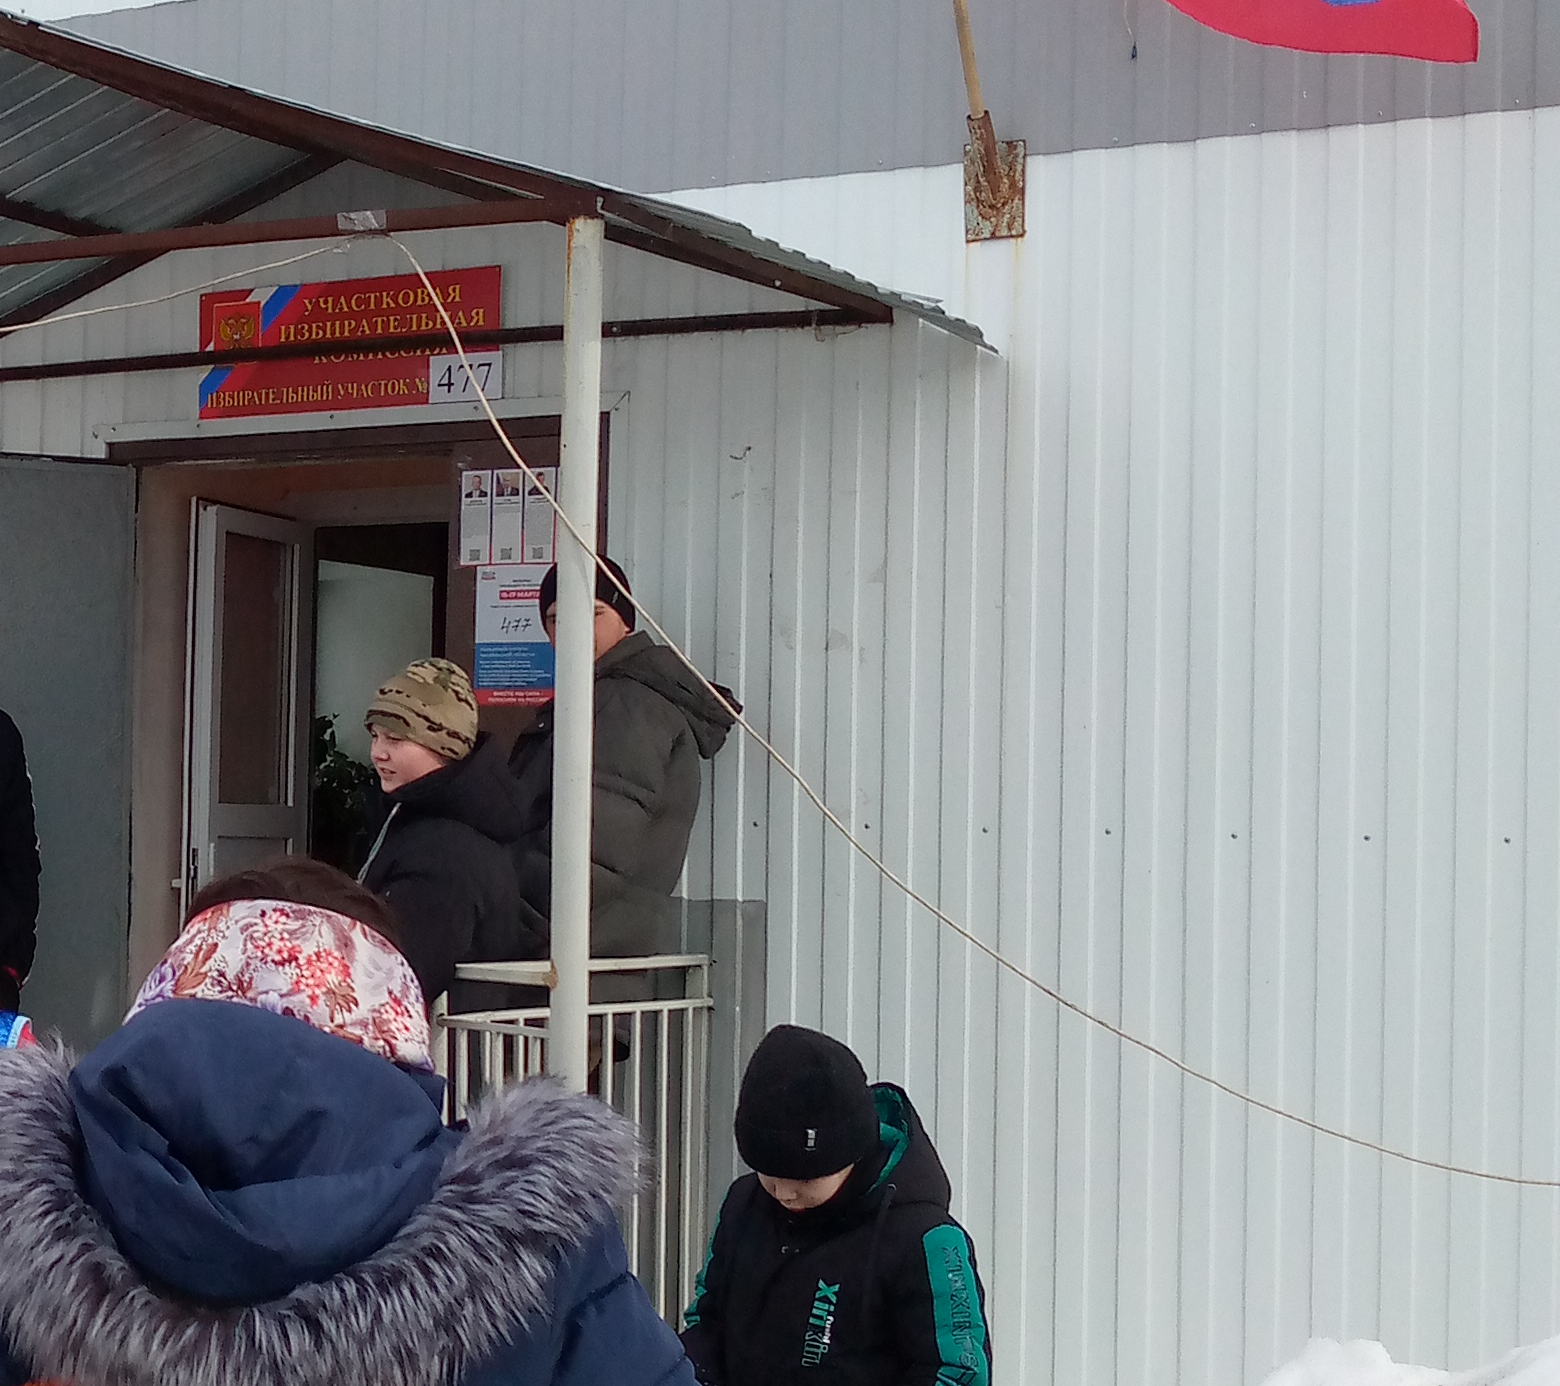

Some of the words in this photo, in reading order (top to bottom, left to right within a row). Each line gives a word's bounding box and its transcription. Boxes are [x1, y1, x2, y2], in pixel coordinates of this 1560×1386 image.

[303, 284, 462, 316] УЧАСТКОВАЯ
[280, 308, 485, 342] ИЗБИРАТЕЛЬНАЯ
[207, 380, 333, 408] ИЗБИРАТЕЛЬНЫЙ
[337, 377, 410, 400] УЧАСТОК
[437, 362, 492, 394] 477
[500, 616, 532, 634] 477
